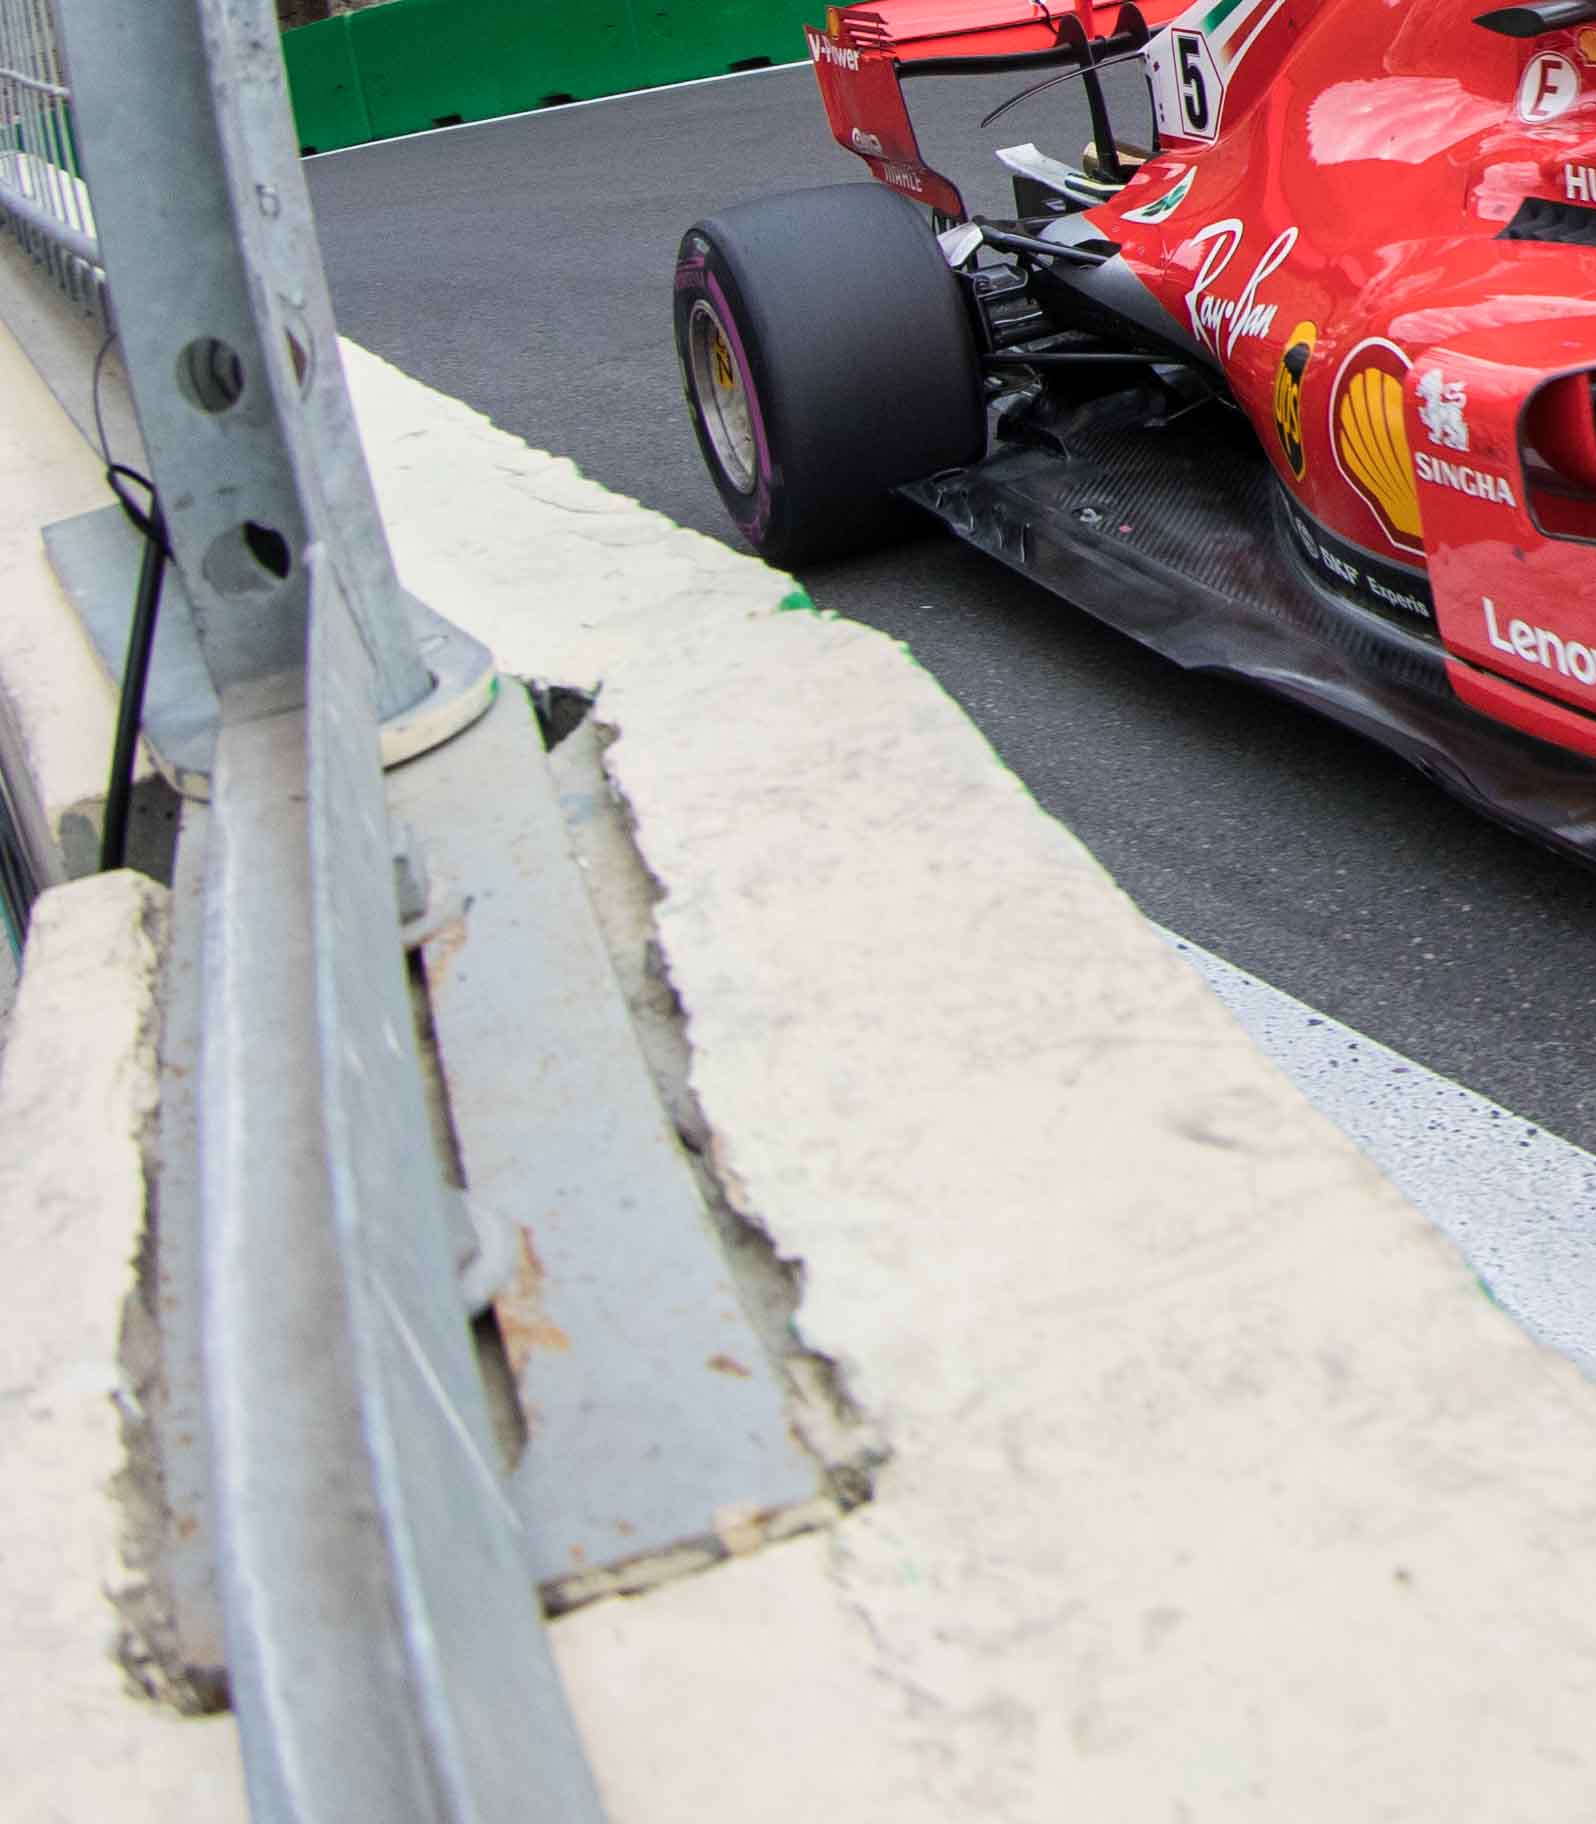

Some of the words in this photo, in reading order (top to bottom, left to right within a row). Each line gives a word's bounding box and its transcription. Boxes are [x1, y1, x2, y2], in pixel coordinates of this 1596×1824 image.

[1177, 36, 1209, 130] 5
[1528, 58, 1563, 117] E
[1415, 450, 1517, 508] SINGHA
